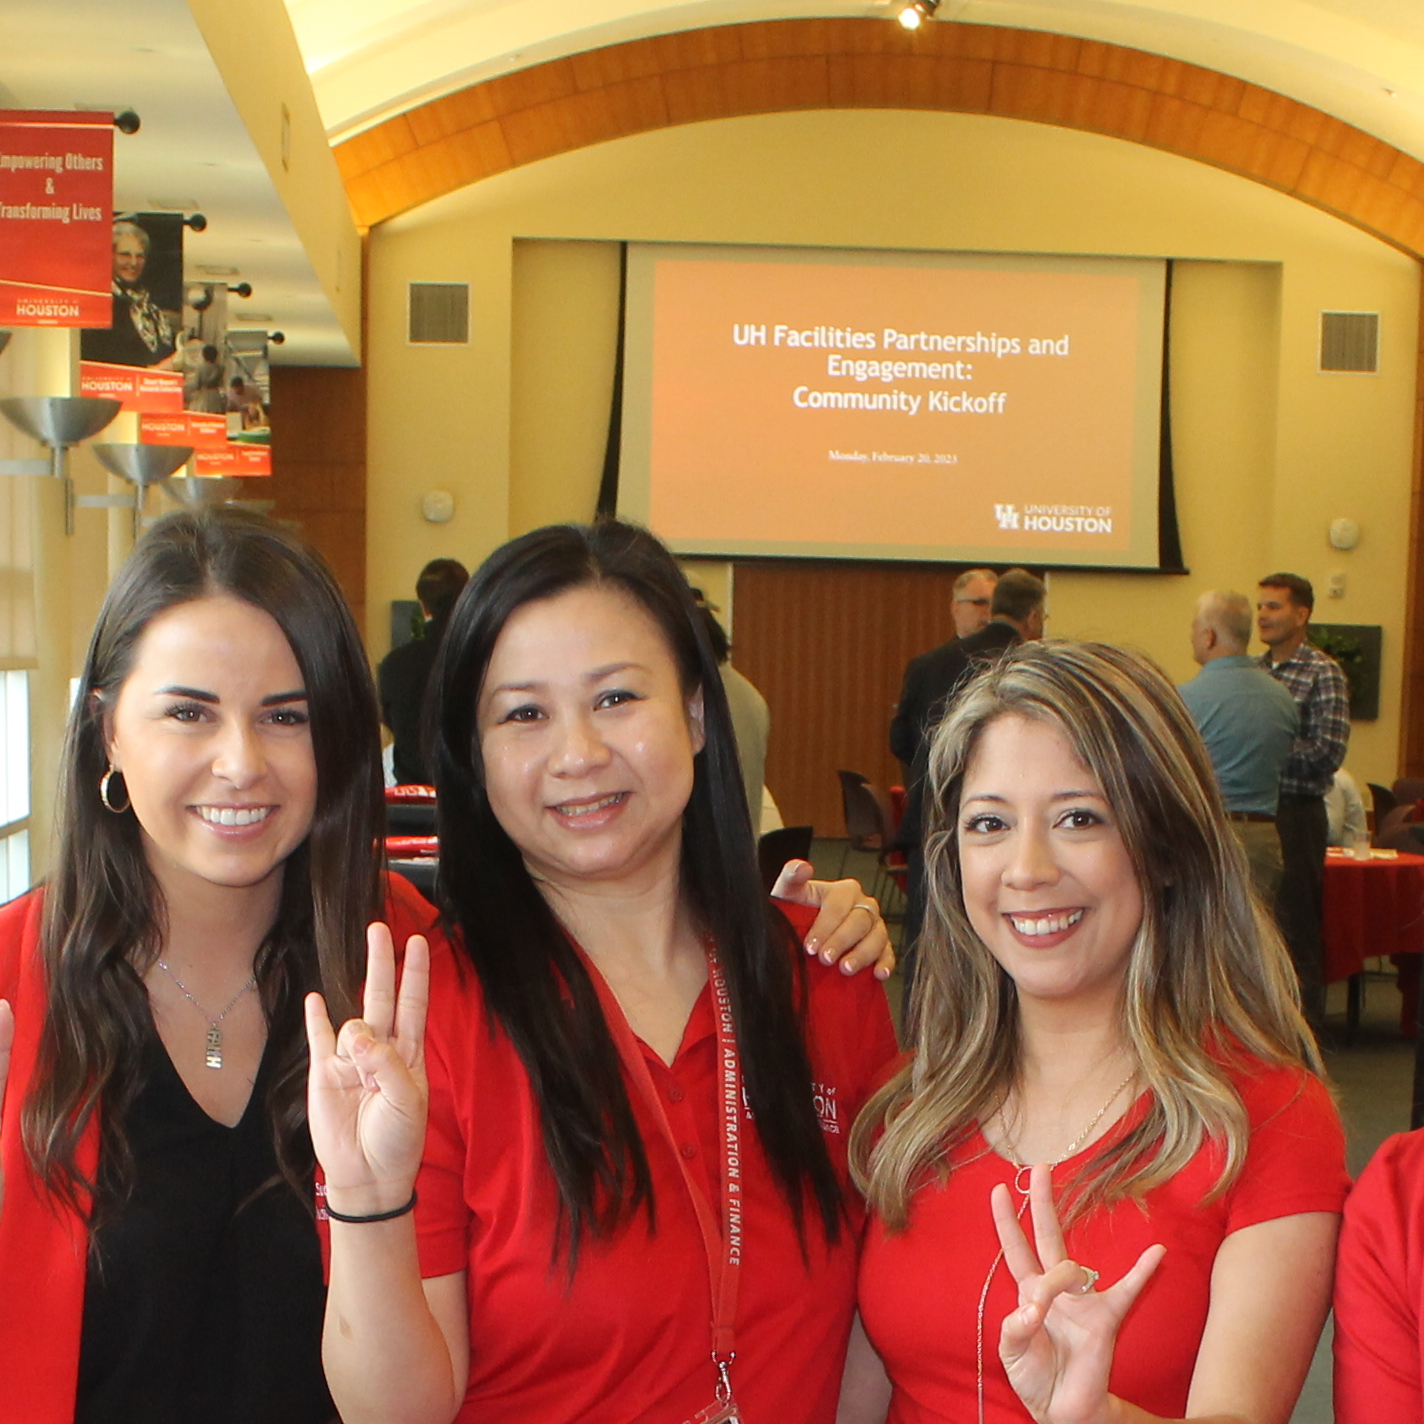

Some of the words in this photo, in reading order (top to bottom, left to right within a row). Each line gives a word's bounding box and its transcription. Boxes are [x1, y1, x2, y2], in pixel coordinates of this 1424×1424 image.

[65, 153, 104, 171] Others
[45, 177, 55, 195] &
[72, 204, 102, 221] Lives
[16, 304, 79, 317] HOUSTON
[733, 324, 766, 346] UH
[774, 325, 877, 349] Facilities
[882, 328, 1021, 357] Partnerships
[1027, 334, 1069, 355] and
[827, 356, 972, 382] Engagement:
[81, 381, 133, 392] HOUSTON
[793, 386, 921, 415] Community
[928, 390, 1007, 414] Kickoff
[141, 423, 185, 432] HOUSTON
[872, 450, 915, 465] February
[933, 453, 958, 464] 2023
[994, 504, 1020, 530] UH
[1024, 504, 1094, 517] UNIVERSITY
[1096, 507, 1112, 517] OF
[1024, 516, 1112, 533] HOUSTON
[712, 968, 734, 1034] HOUSTON
[723, 1047, 741, 1178] ADMINISTRATION
[729, 1182, 740, 1193] &
[729, 1198, 742, 1266] FINANCE
